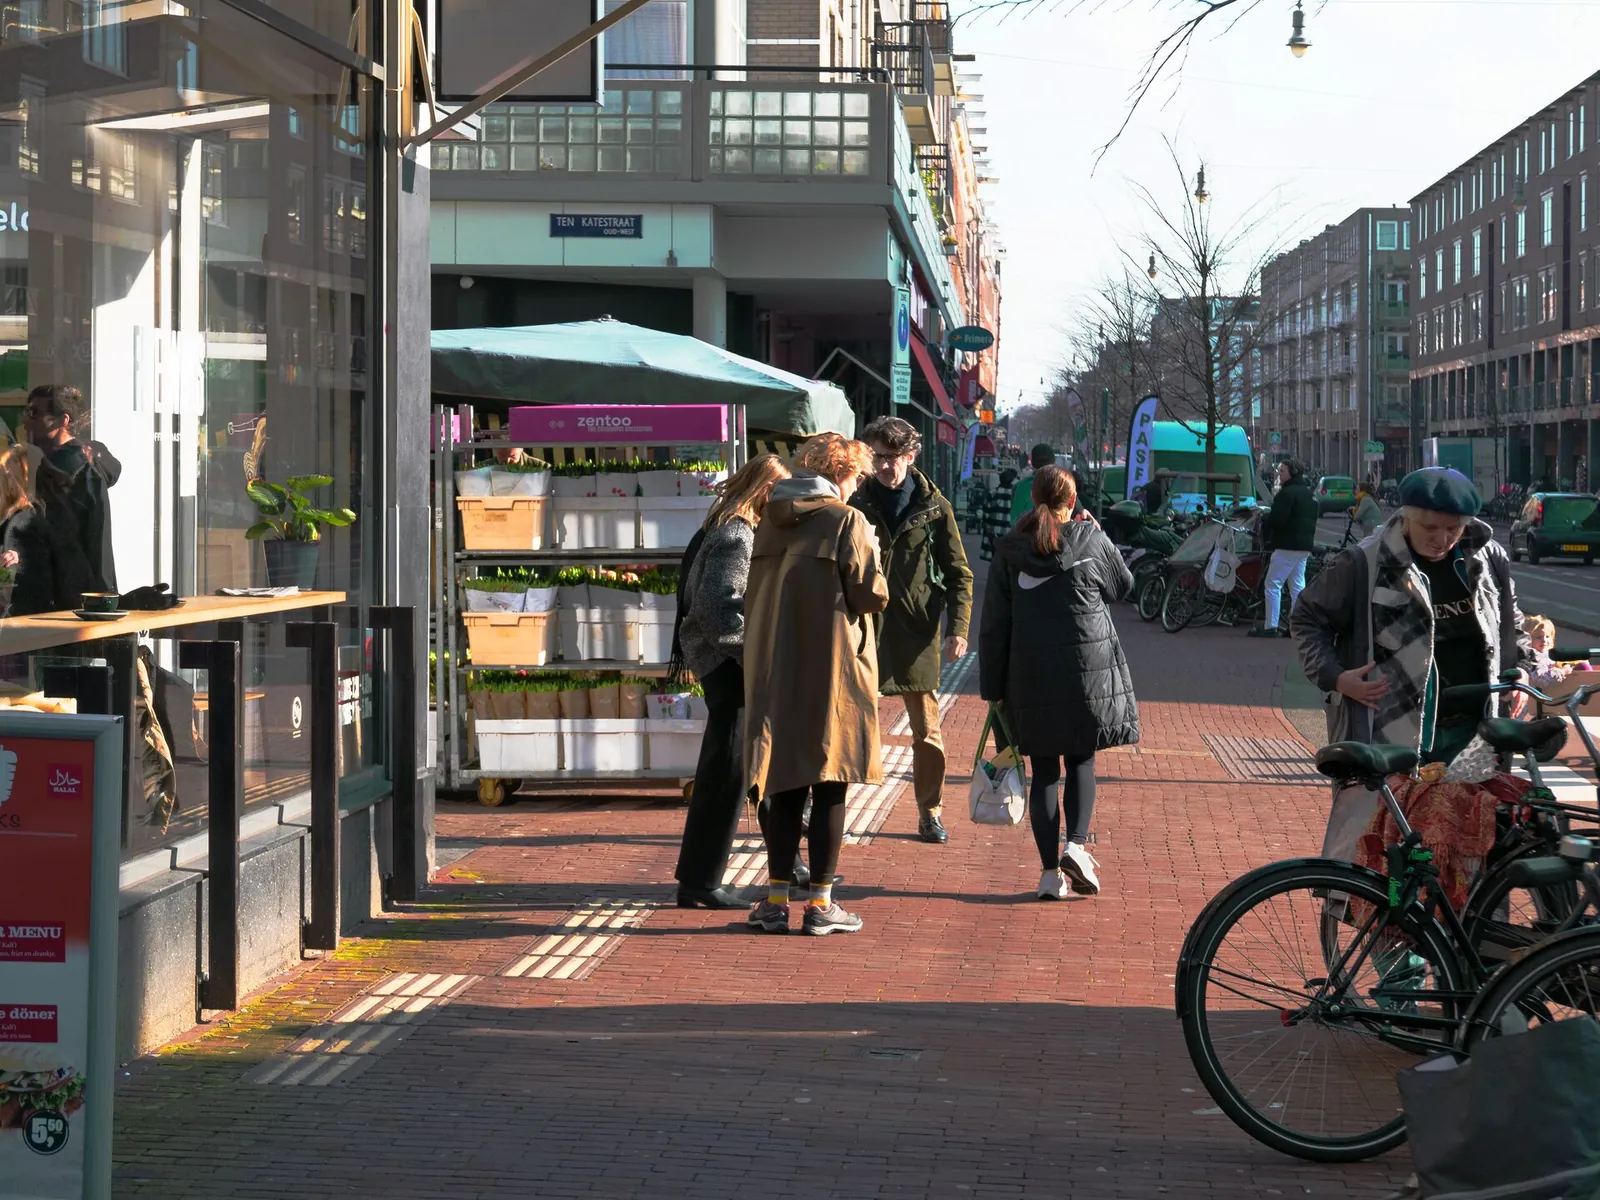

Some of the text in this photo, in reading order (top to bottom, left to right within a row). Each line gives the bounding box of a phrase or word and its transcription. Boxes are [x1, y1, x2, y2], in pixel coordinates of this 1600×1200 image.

[556, 217, 635, 227] TEN KATESTRAAT
[577, 415, 631, 427] zentoo
[49, 769, 80, 786] حلال
[8, 926, 62, 938] MENU
[9, 1007, 56, 1020] döner
